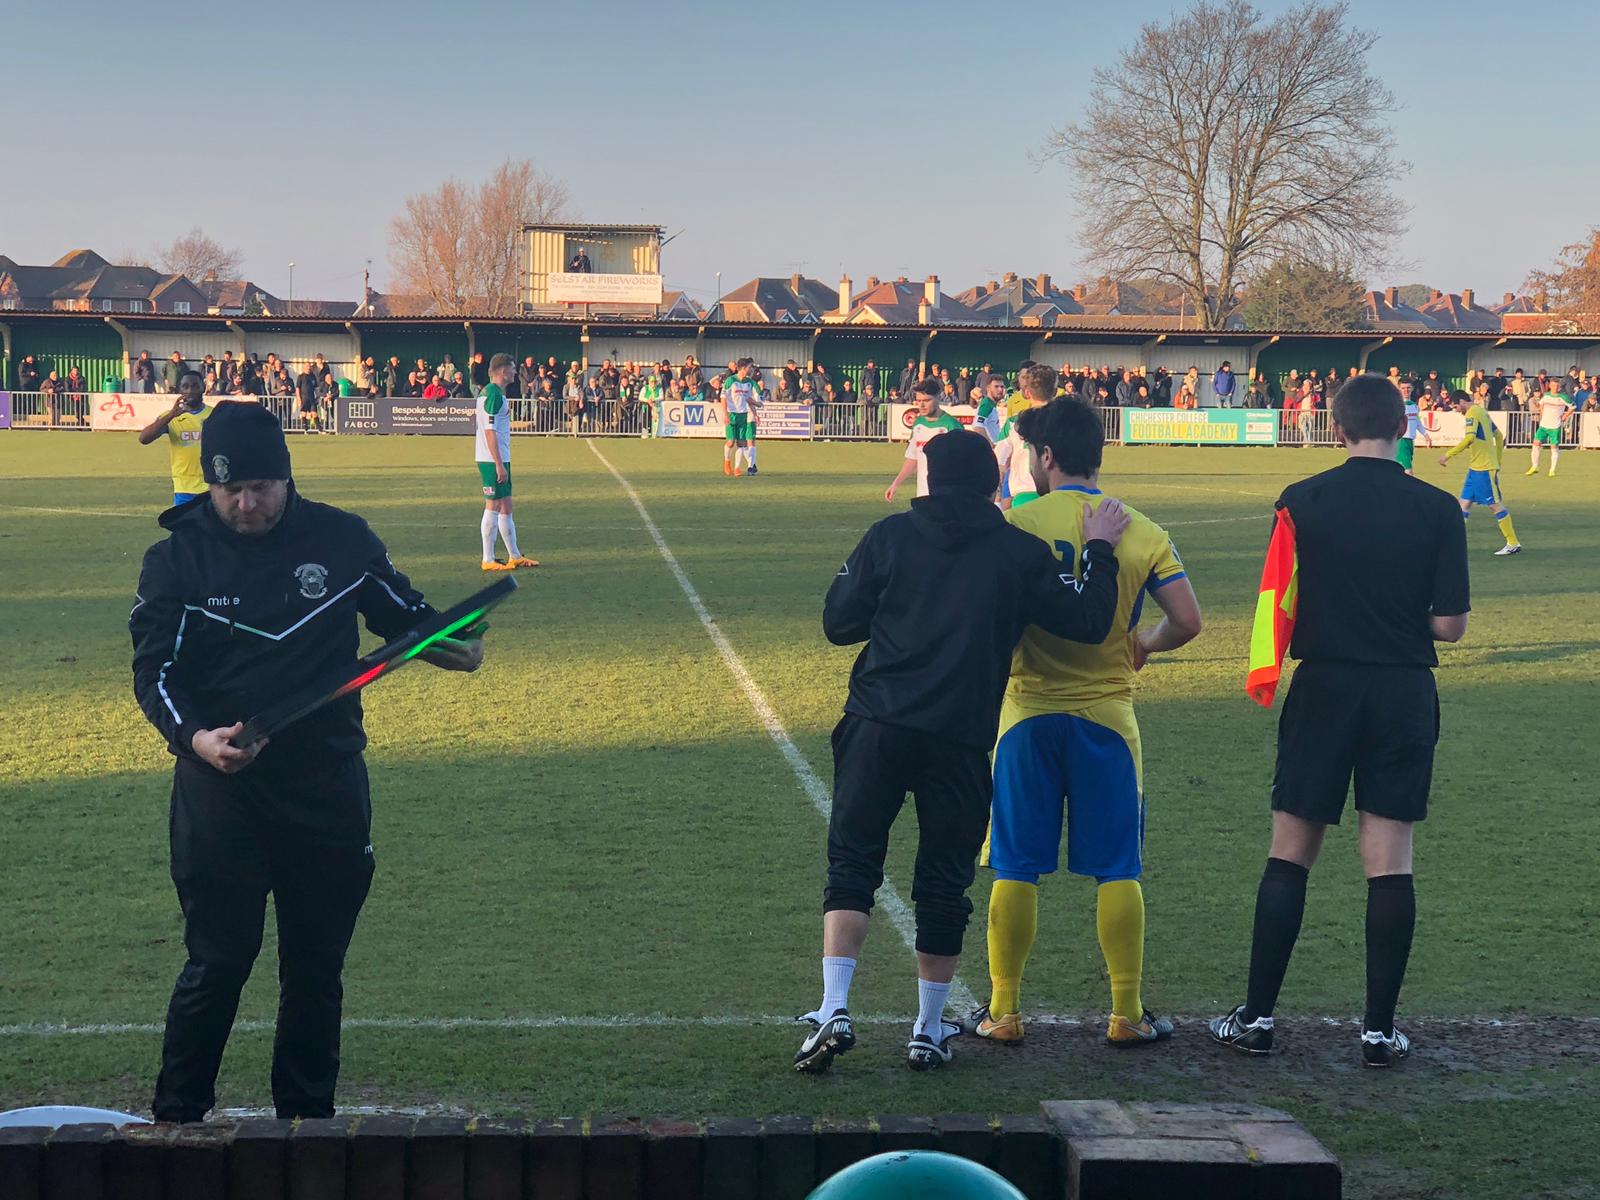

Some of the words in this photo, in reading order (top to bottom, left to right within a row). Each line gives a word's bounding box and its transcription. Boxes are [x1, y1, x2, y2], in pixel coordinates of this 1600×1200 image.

[598, 275, 659, 286] FIREWORKS
[392, 406, 426, 415] Bespoke
[428, 406, 448, 414] Steel
[669, 407, 719, 424] GWA
[1131, 412, 1174, 423] CHICHESTER
[1177, 412, 1208, 423] COLLEGE
[344, 421, 379, 429] FABCO
[1132, 424, 1184, 438] FOOTBALL
[1187, 425, 1236, 439] ACADEMY
[831, 1022, 851, 1034] NIK
